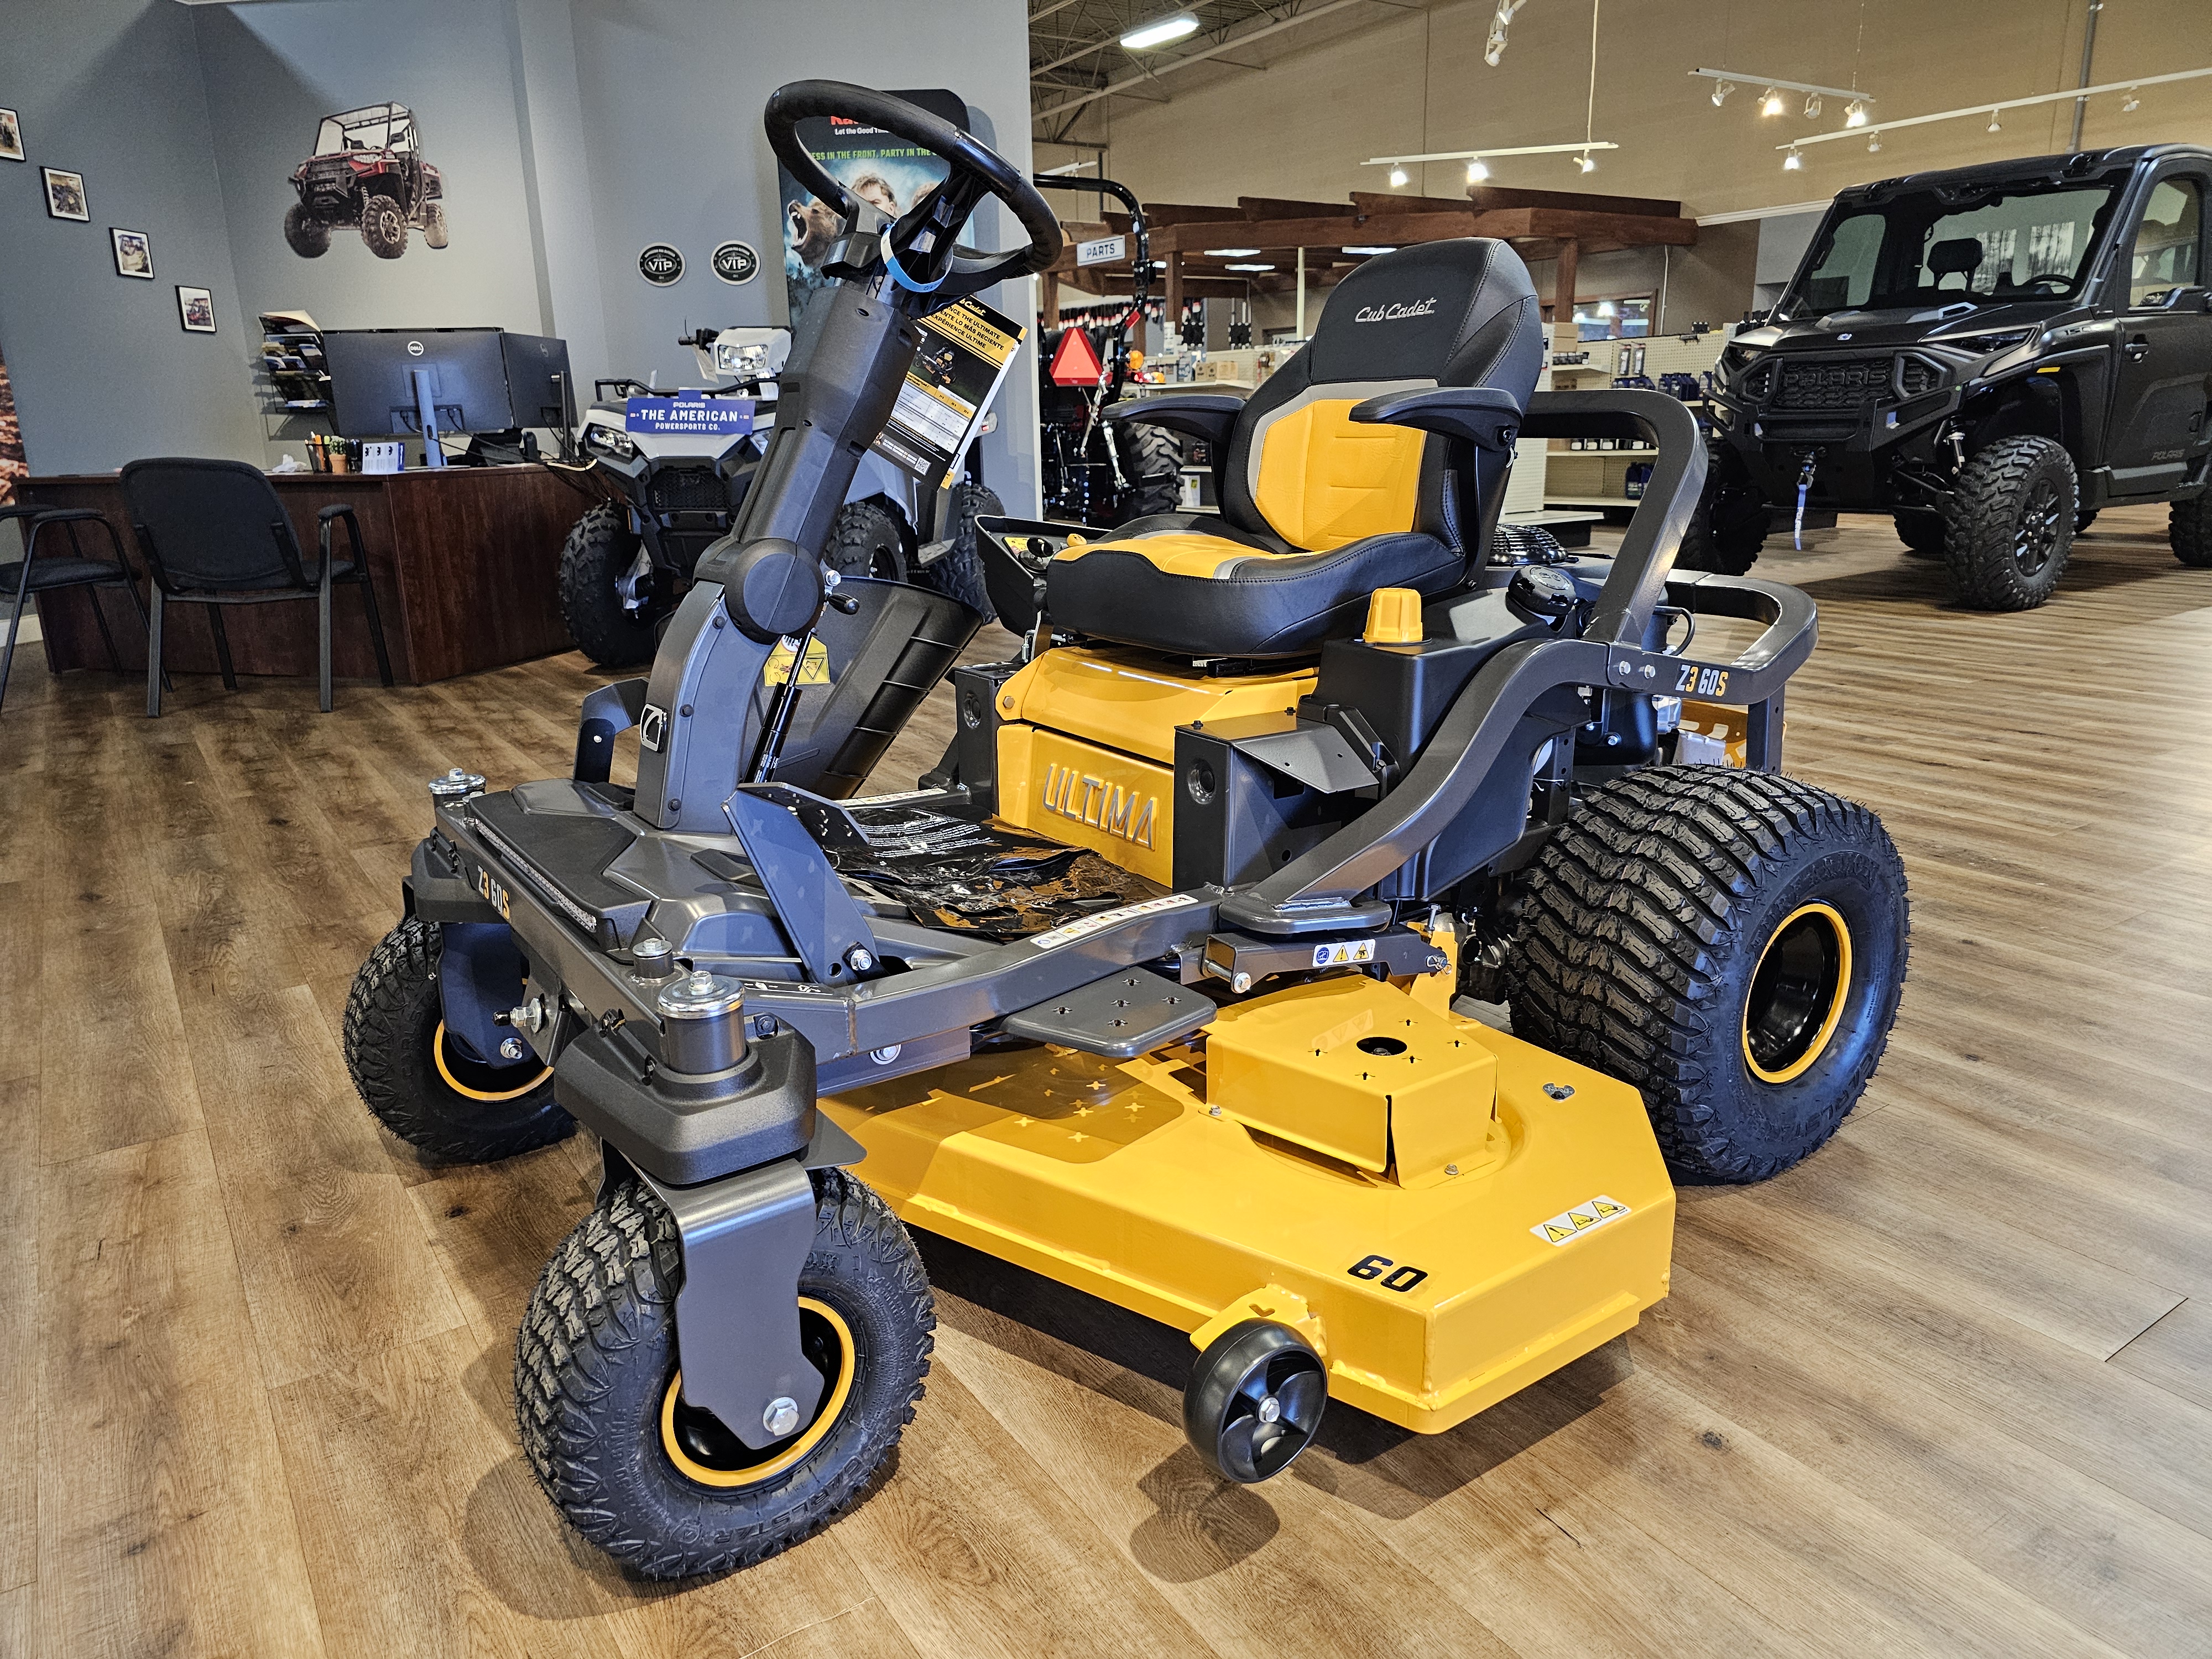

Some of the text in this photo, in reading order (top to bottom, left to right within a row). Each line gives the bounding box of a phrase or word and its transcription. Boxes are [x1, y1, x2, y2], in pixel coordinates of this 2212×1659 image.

[880, 149, 904, 159] PARTY
[906, 148, 915, 156] IN
[1087, 243, 1115, 259] PARTS
[649, 261, 672, 271] VIP
[722, 259, 747, 269] VIP
[1355, 297, 1436, 323] Cub Cadet
[940, 310, 954, 321] ENTE
[964, 323, 976, 333] MÁS
[977, 332, 1004, 350] RECIENTE
[962, 314, 973, 323] THE
[973, 320, 1000, 340] ULTIMATE
[966, 334, 986, 348] ULTIME
[1783, 370, 1886, 387] POLARIS
[641, 409, 738, 421] THE AMERICAN
[655, 422, 706, 430] POWERSPORTS
[1675, 664, 1729, 696] Z3 60S
[1043, 762, 1159, 851] ULTIMA
[477, 865, 510, 919] Z3 60S
[1346, 1254, 1428, 1292] 60
